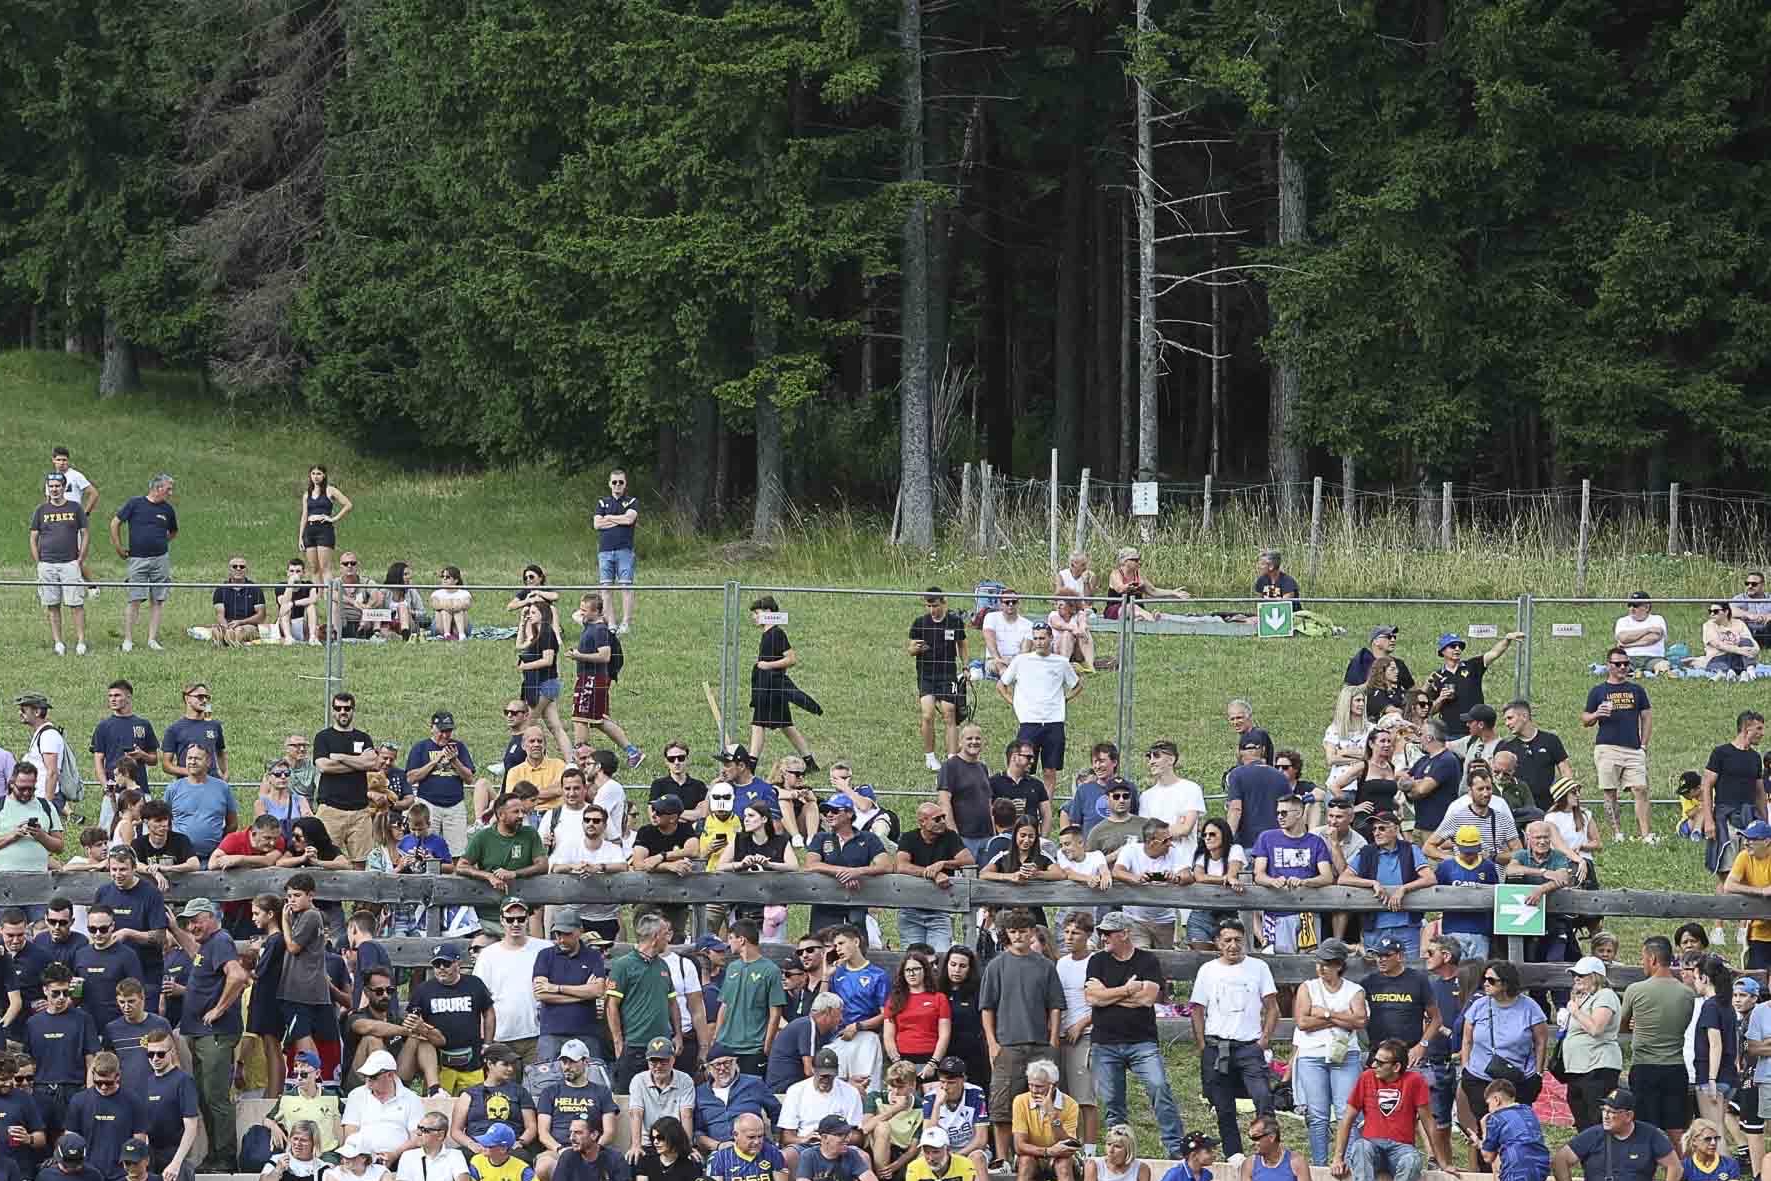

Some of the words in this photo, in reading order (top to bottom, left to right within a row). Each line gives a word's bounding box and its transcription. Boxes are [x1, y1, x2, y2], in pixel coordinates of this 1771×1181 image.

[43, 512, 74, 523] PYREX
[1372, 993, 1413, 1003] VERONA
[555, 1096, 594, 1107] HELLAS
